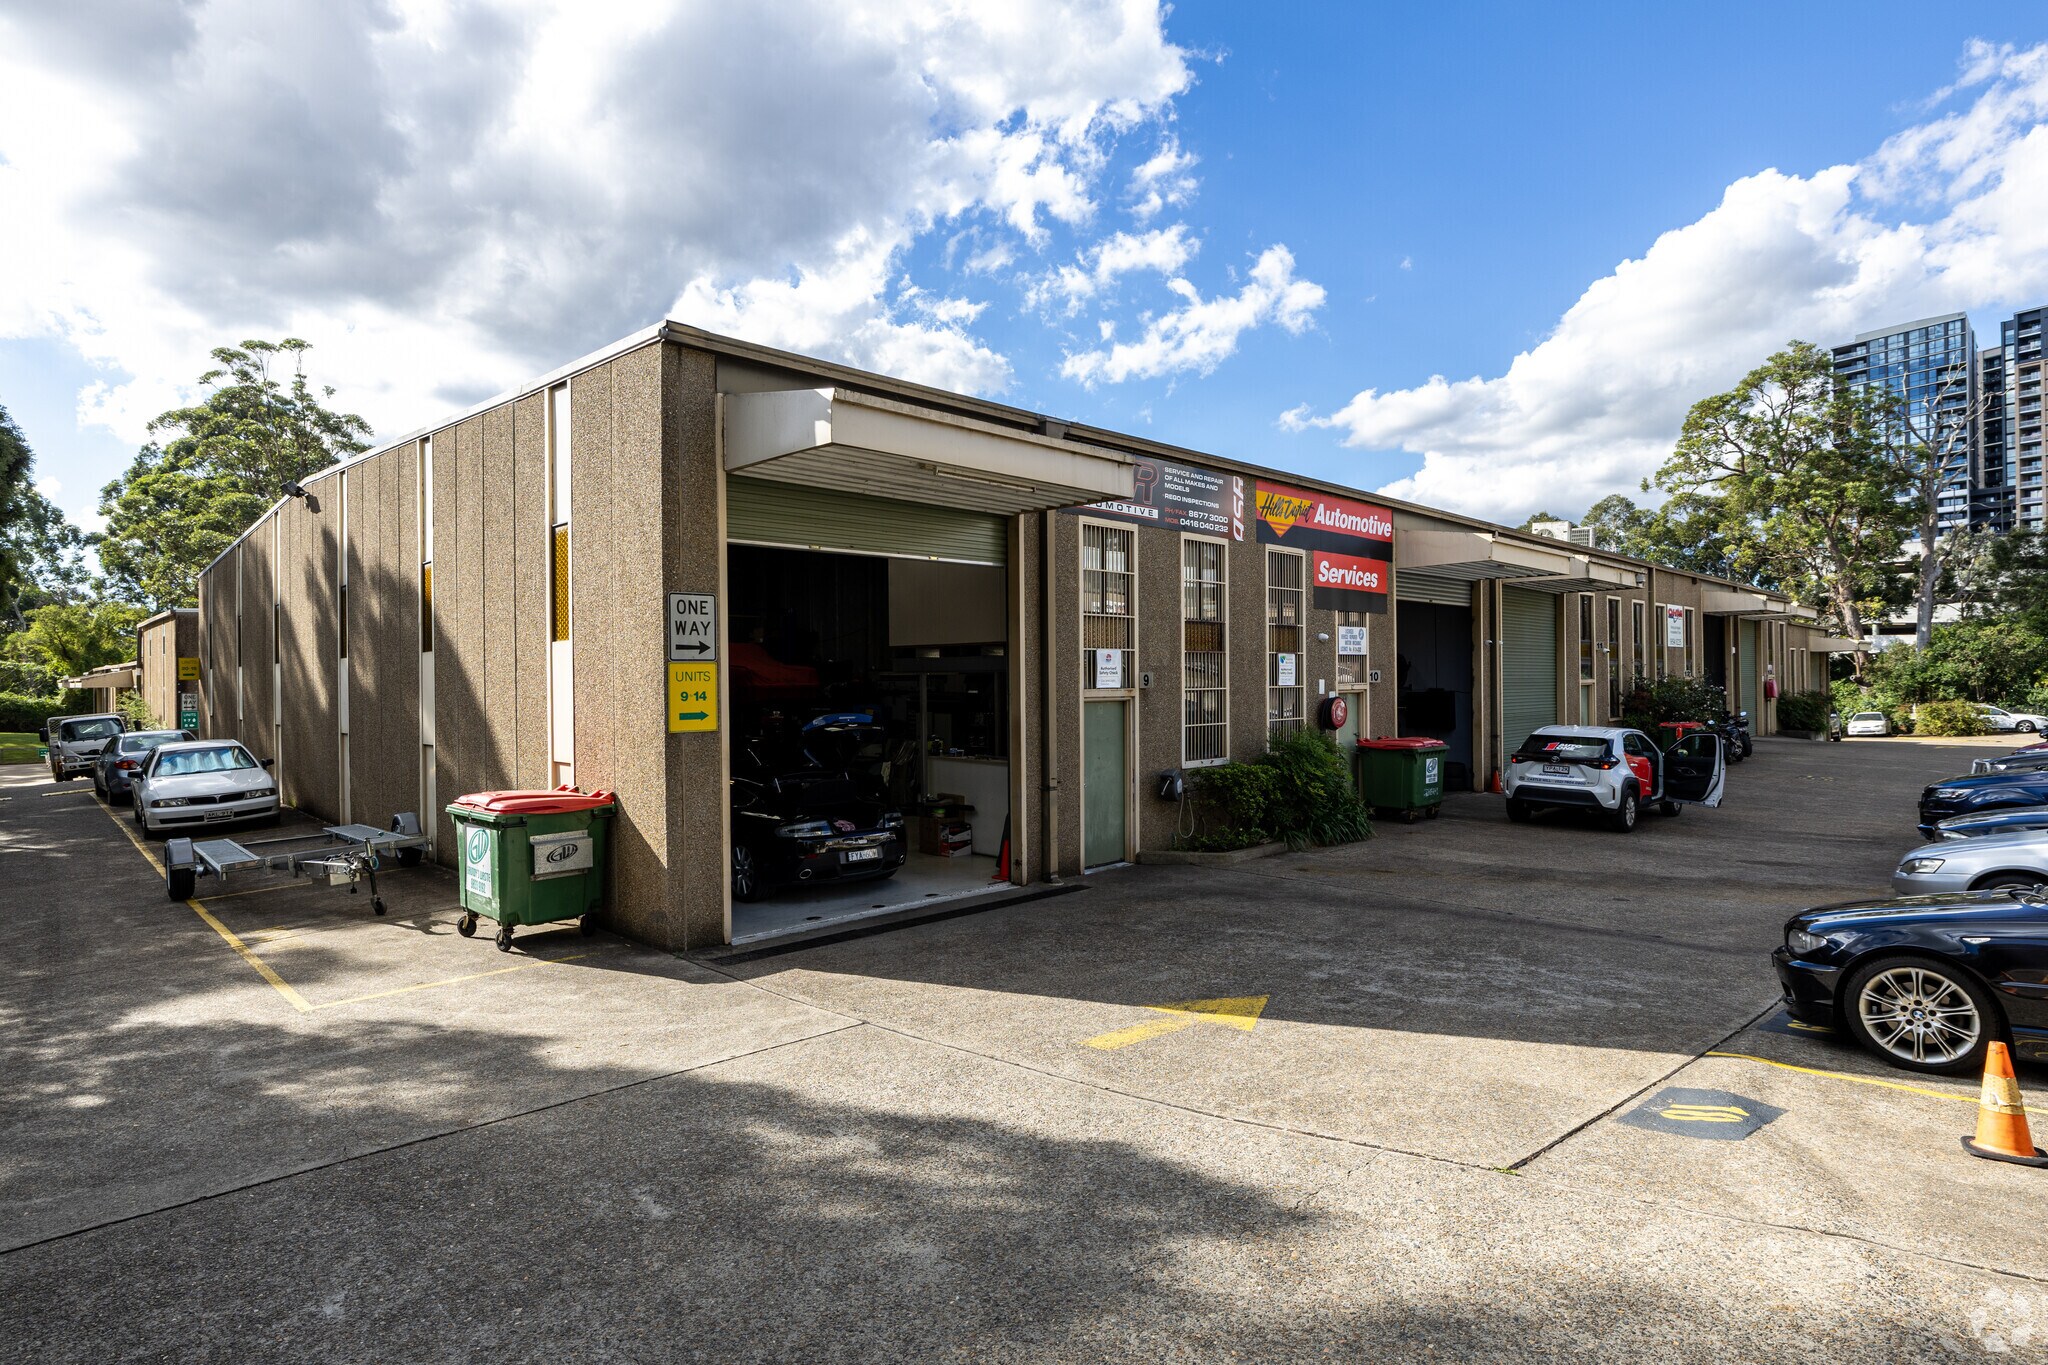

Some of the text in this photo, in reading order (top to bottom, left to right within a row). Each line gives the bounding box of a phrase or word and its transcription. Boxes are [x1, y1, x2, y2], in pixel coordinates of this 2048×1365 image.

[1165, 467, 1190, 477] SERVICE
[1204, 476, 1224, 485] REPAIR
[1165, 483, 1190, 493] MODELS
[1185, 479, 1206, 489] MAKES
[1165, 493, 1219, 509] REGO INSPECTIONS
[1260, 492, 1284, 519] Hills
[1188, 510, 1209, 520] 8677
[1209, 514, 1229, 524] 3000
[1313, 503, 1392, 537] Automotive
[1180, 518, 1199, 528] 0416
[1199, 522, 1214, 531] 040
[1214, 524, 1229, 533] 232
[1318, 560, 1378, 588] Services
[676, 599, 709, 615] ONE
[674, 620, 711, 636] WAY
[675, 671, 711, 682] UNITS
[1143, 674, 1150, 687] 9
[1369, 671, 1379, 681] 10
